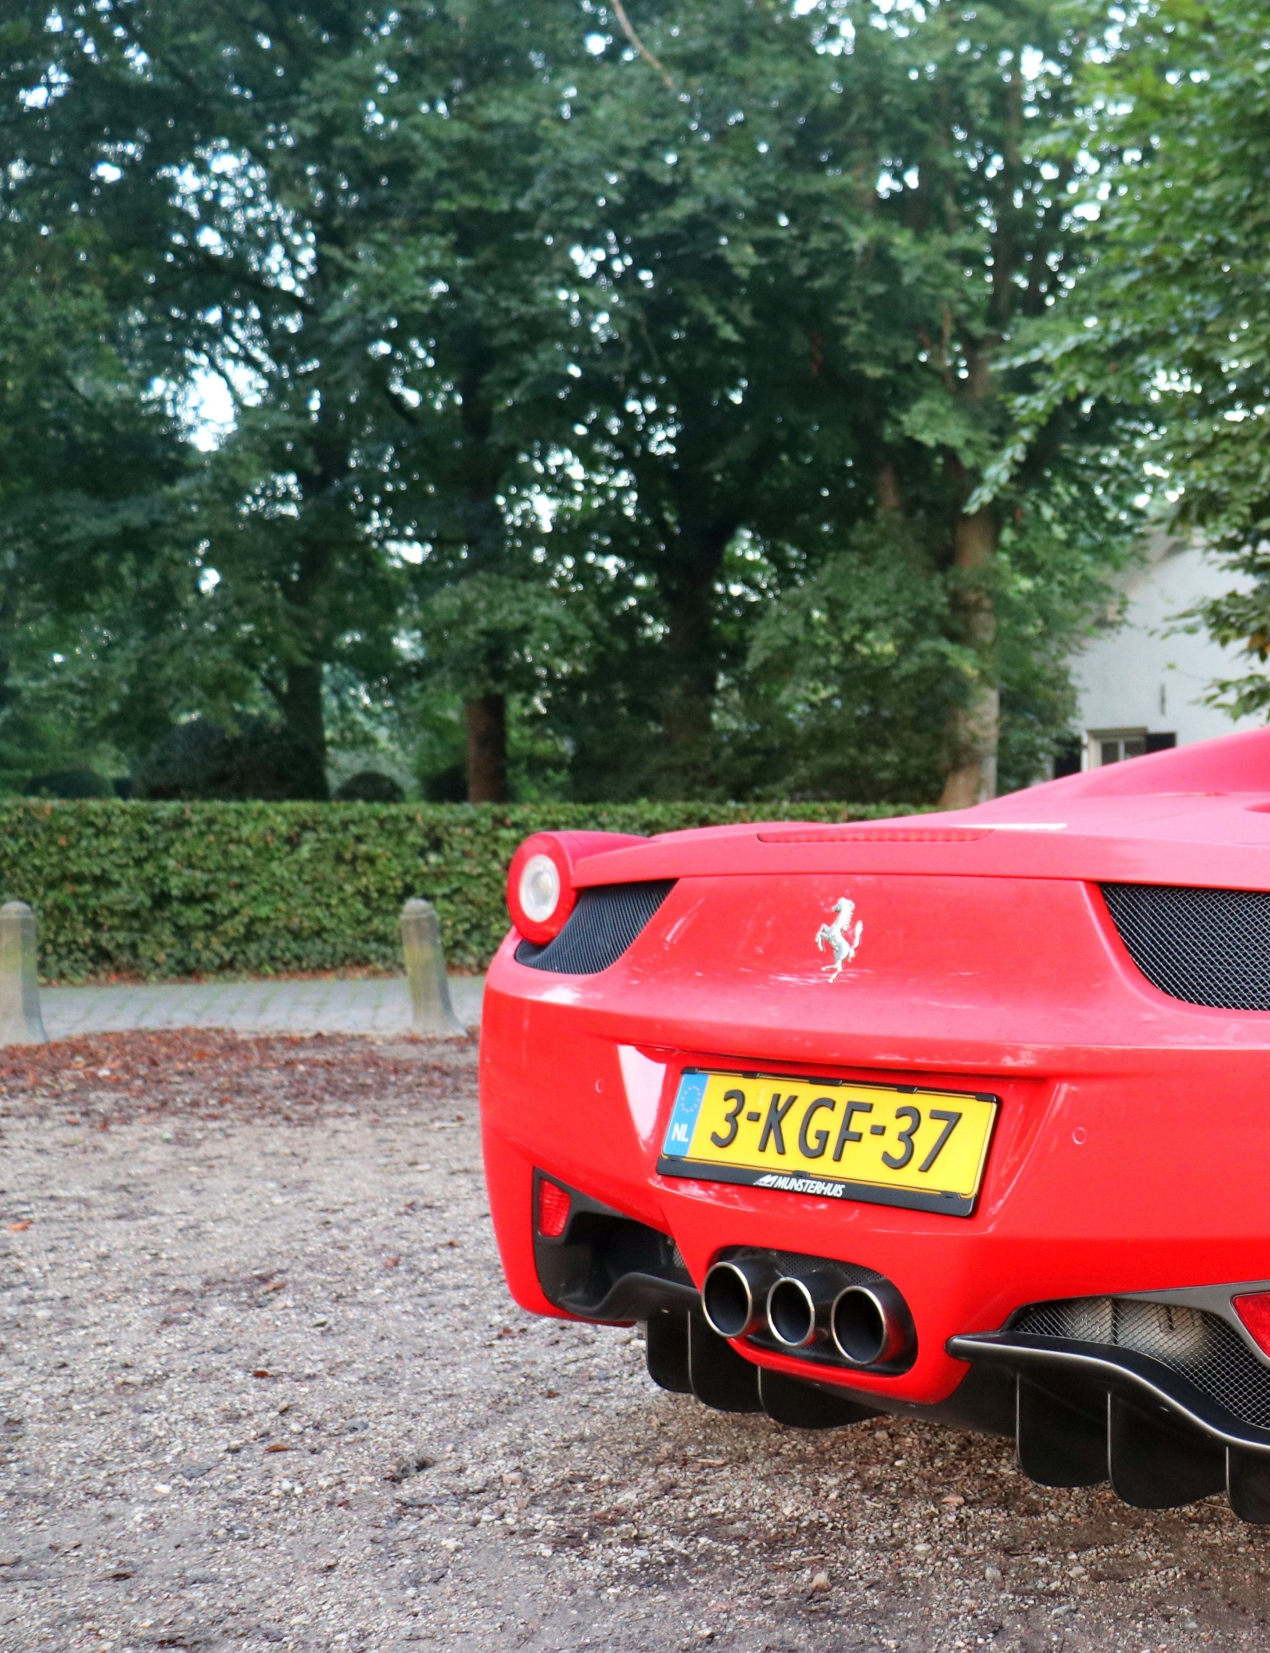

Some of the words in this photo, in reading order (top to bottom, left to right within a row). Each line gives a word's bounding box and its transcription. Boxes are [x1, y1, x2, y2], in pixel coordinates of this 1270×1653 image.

[671, 1123, 689, 1144] NL
[710, 1088, 963, 1173] 3-KGF-37
[774, 1175, 846, 1198] MUNSTERHUIS
